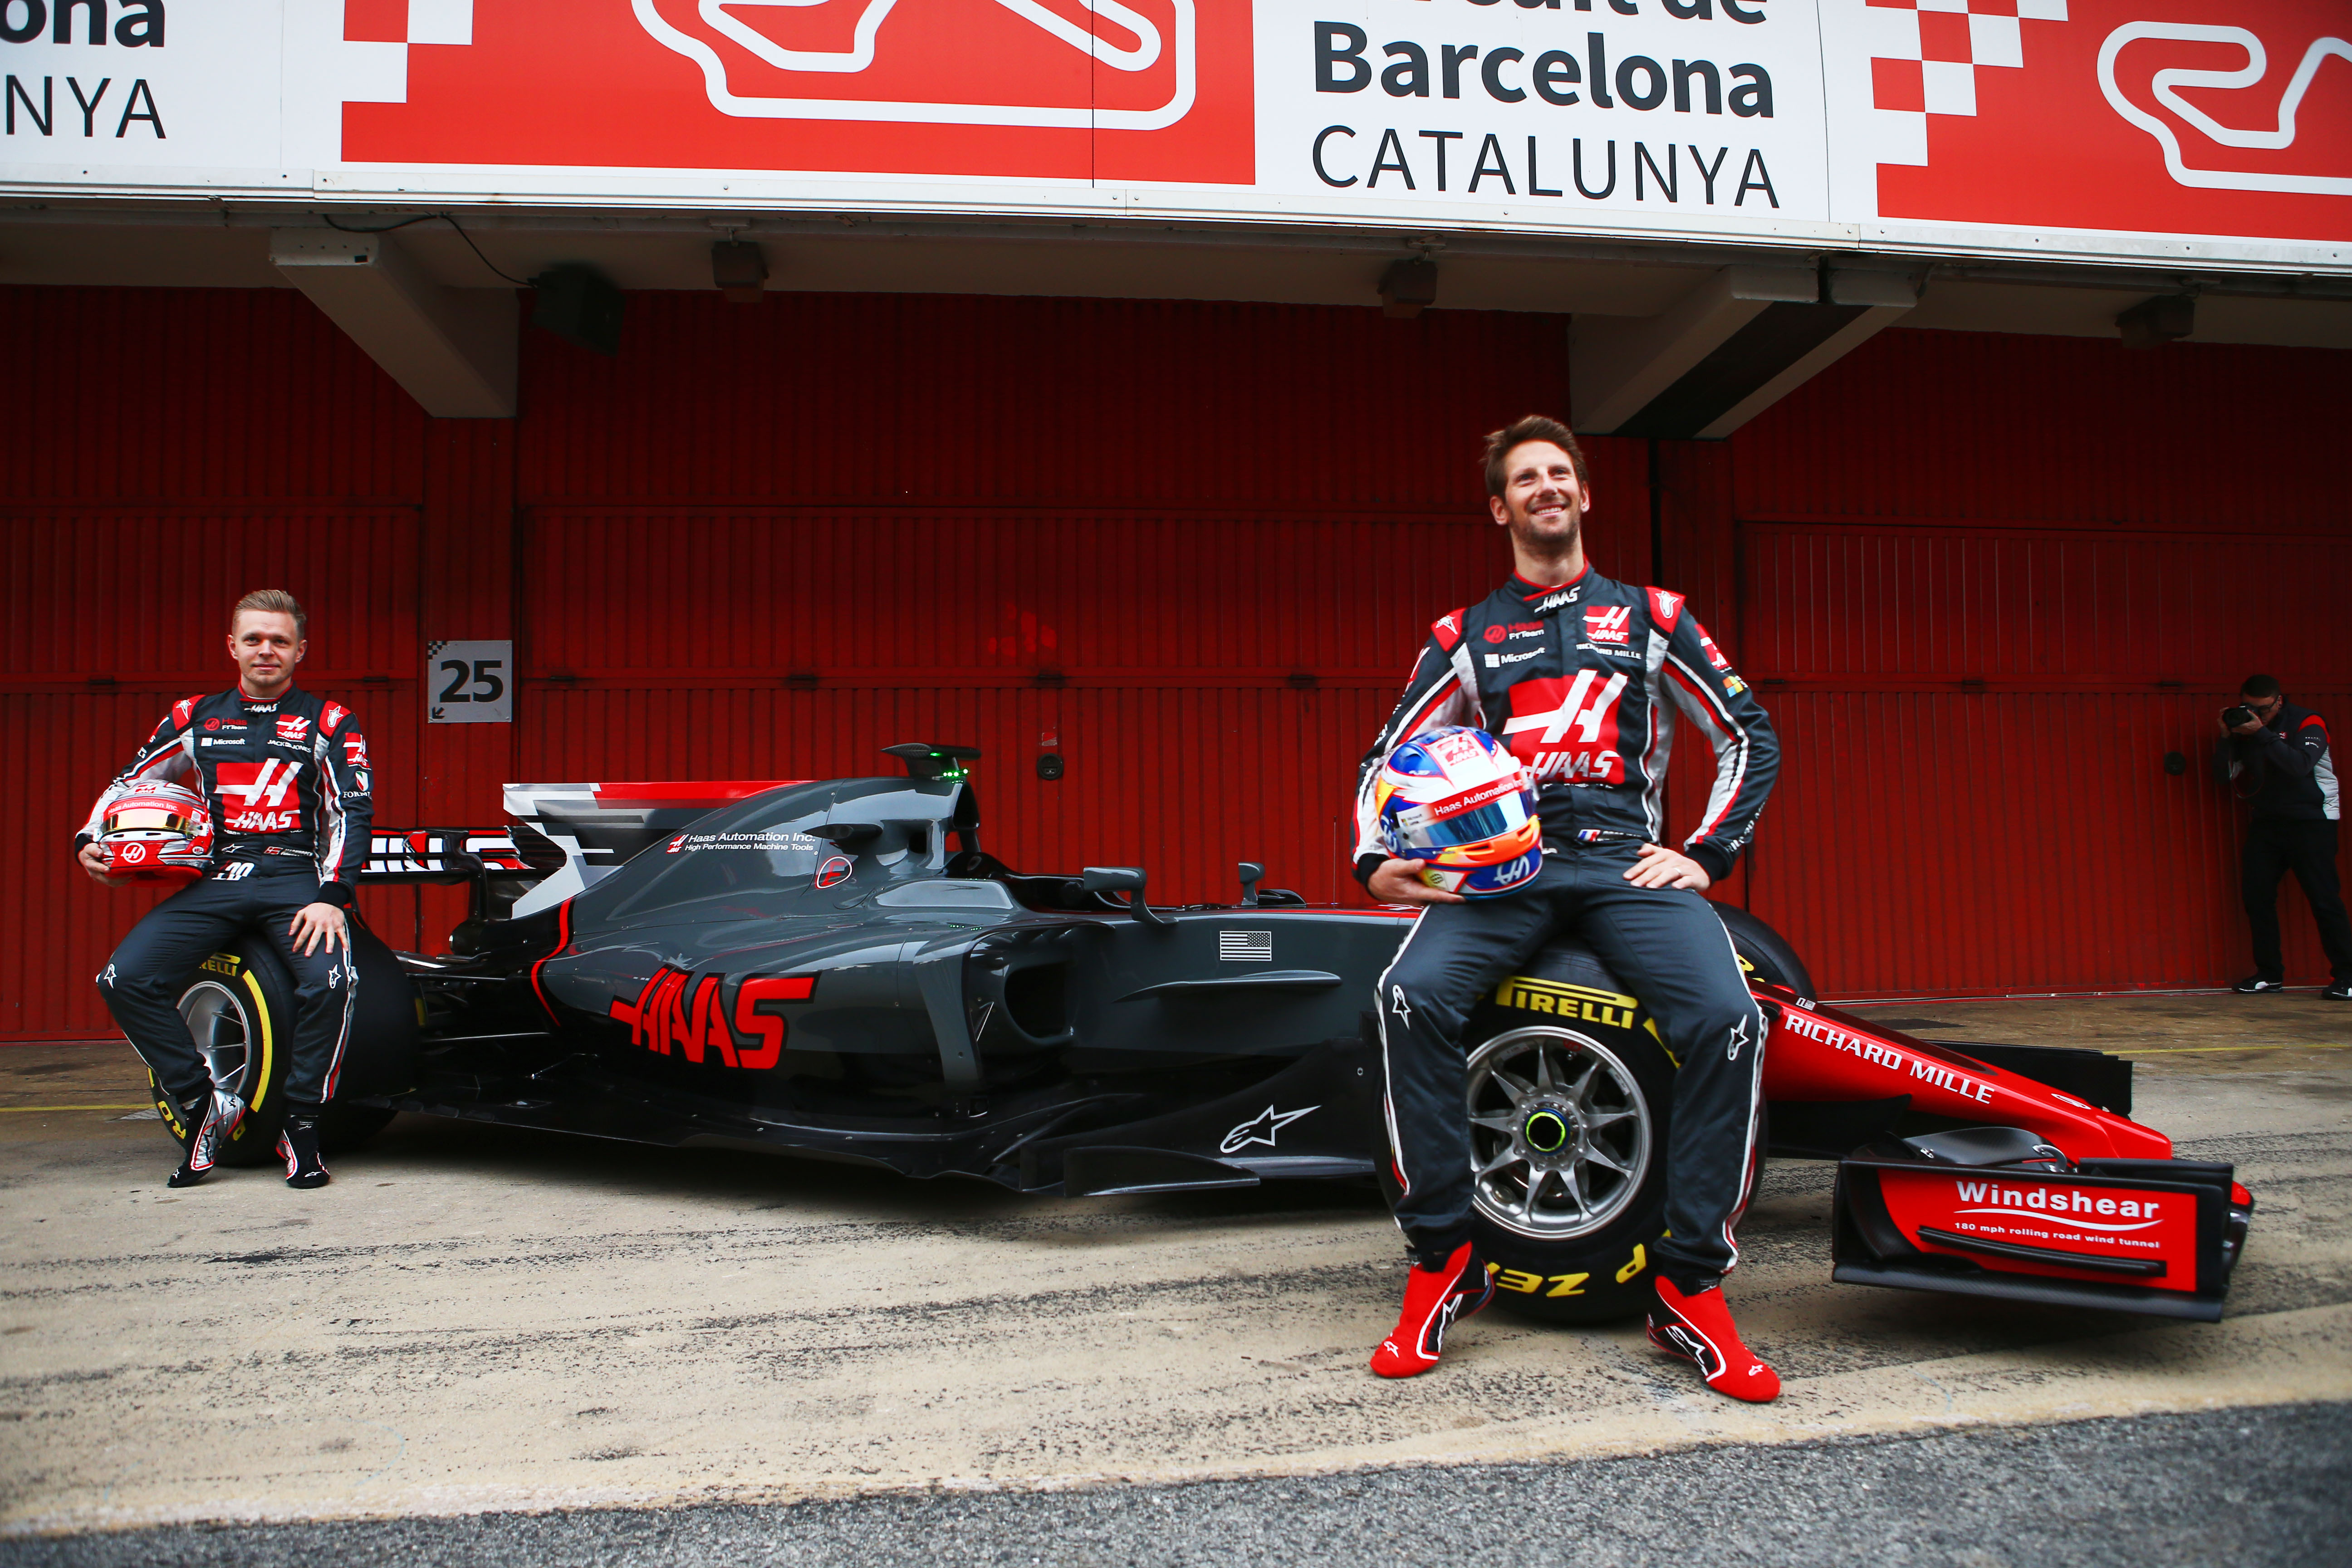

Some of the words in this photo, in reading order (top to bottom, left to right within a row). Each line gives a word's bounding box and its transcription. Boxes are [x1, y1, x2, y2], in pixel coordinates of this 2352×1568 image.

[1314, 20, 1774, 118] Barcelona
[6, 74, 167, 139] NYA
[1312, 124, 1780, 209] CATALUNYA
[1534, 585, 1581, 613] HAAS
[1586, 629, 1629, 642] HAAS
[1500, 647, 1546, 664] Microsoft
[1614, 649, 1642, 660] MILLE
[440, 660, 504, 703] 25
[244, 703, 279, 713] HAAS
[277, 730, 308, 739] HAAS
[1523, 750, 1621, 779] HAAS
[108, 804, 121, 815] Haas
[122, 801, 164, 809] Automation
[166, 803, 179, 812] Inc.
[1434, 801, 1462, 816] Haas
[1463, 782, 1514, 806] Automation
[225, 809, 300, 832] HAAS
[685, 843, 701, 852] High
[702, 843, 751, 851] Performance
[791, 843, 813, 851] Tools
[687, 834, 716, 843] Haas
[718, 832, 789, 842] Automation
[792, 832, 816, 843] Inc.
[1495, 975, 1639, 1030] PIRELLI
[608, 967, 816, 1070] HAAS
[1784, 1014, 1902, 1070] RICHARD
[1909, 1060, 1995, 1105] MILLE
[1955, 1181, 2159, 1219] Windshear
[1955, 1222, 1976, 1230] 180
[1980, 1225, 2005, 1234] mph
[2009, 1228, 2049, 1239] rolling
[2053, 1231, 2081, 1241] road
[2084, 1235, 2115, 1244] wind
[2118, 1237, 2160, 1249] tunnel
[1616, 1243, 1646, 1284] P
[1487, 1262, 1589, 1298] ZE
